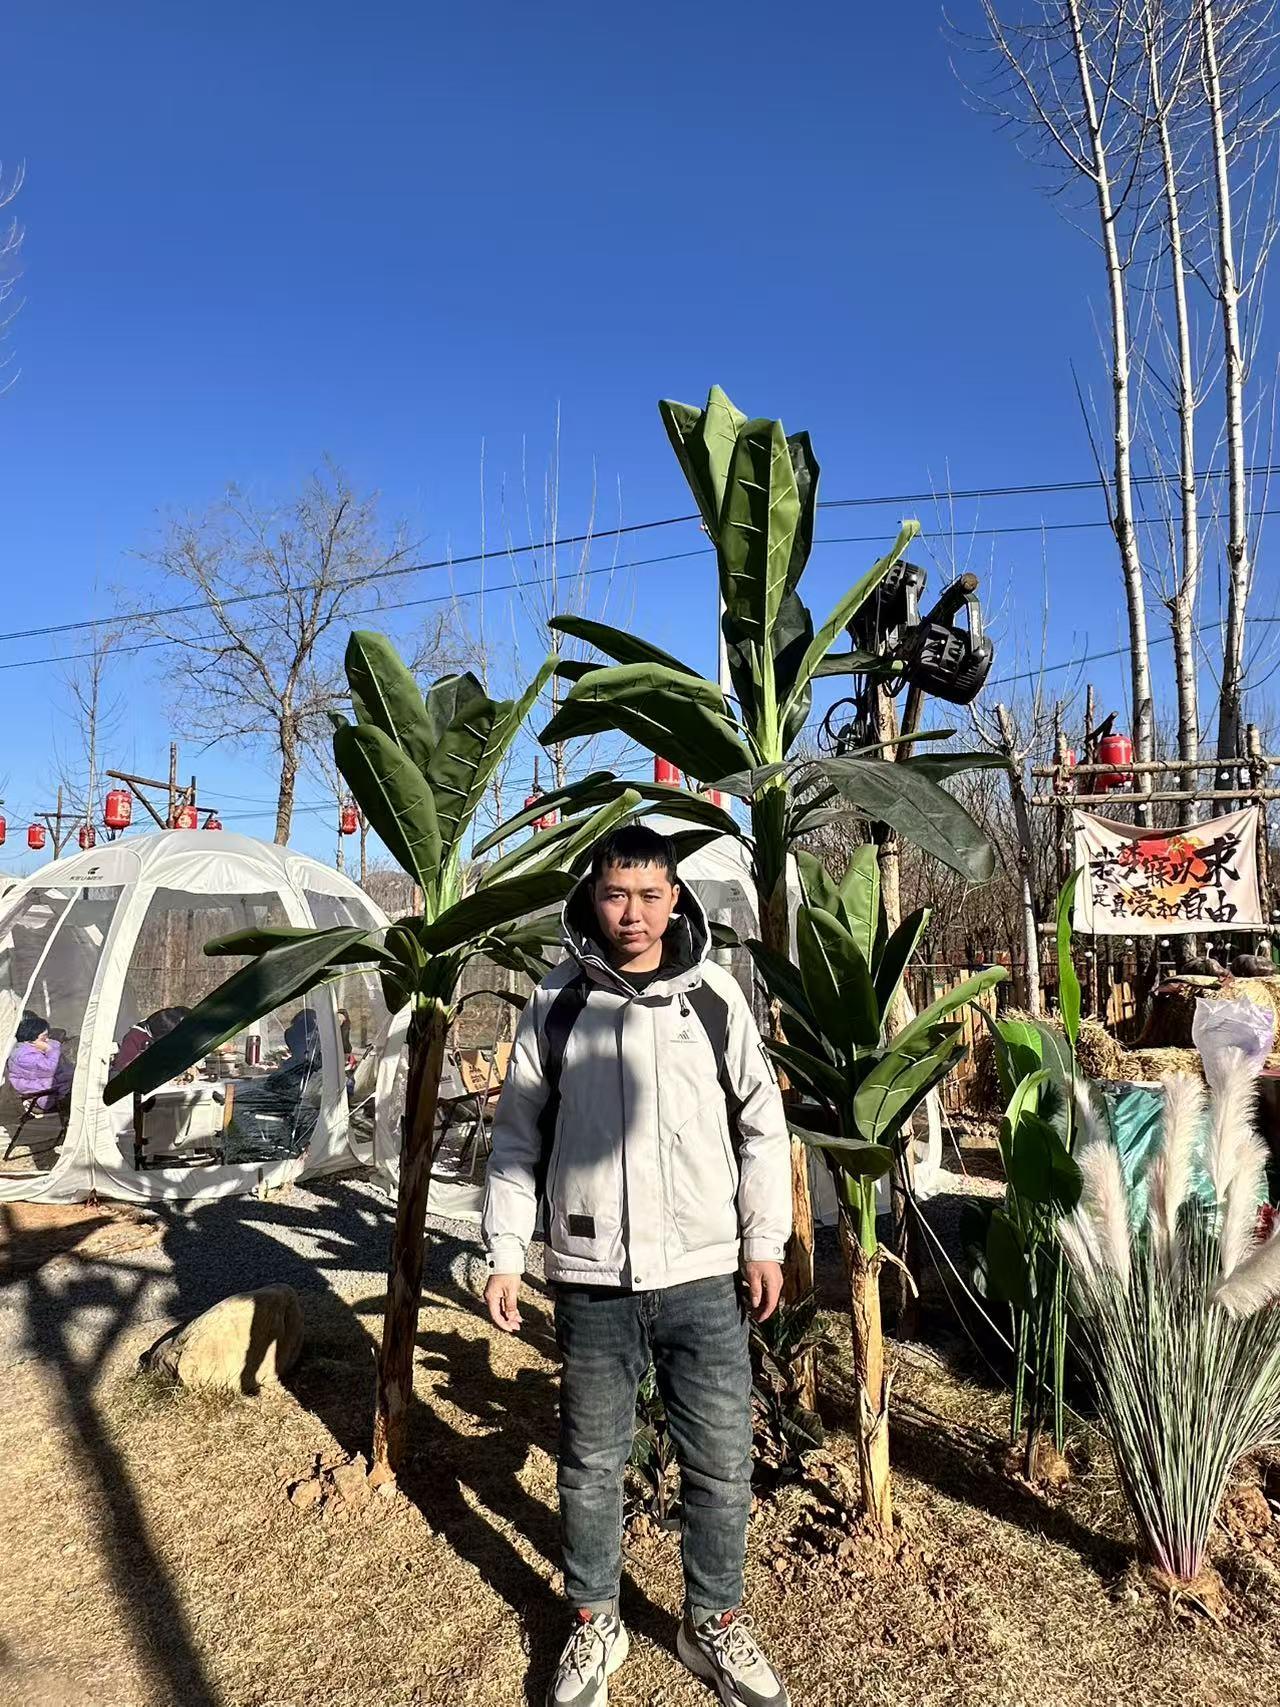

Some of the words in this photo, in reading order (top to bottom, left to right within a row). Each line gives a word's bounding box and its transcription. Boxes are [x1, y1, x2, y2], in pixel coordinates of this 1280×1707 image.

[1092, 884, 1238, 923] 是真爱和自由
